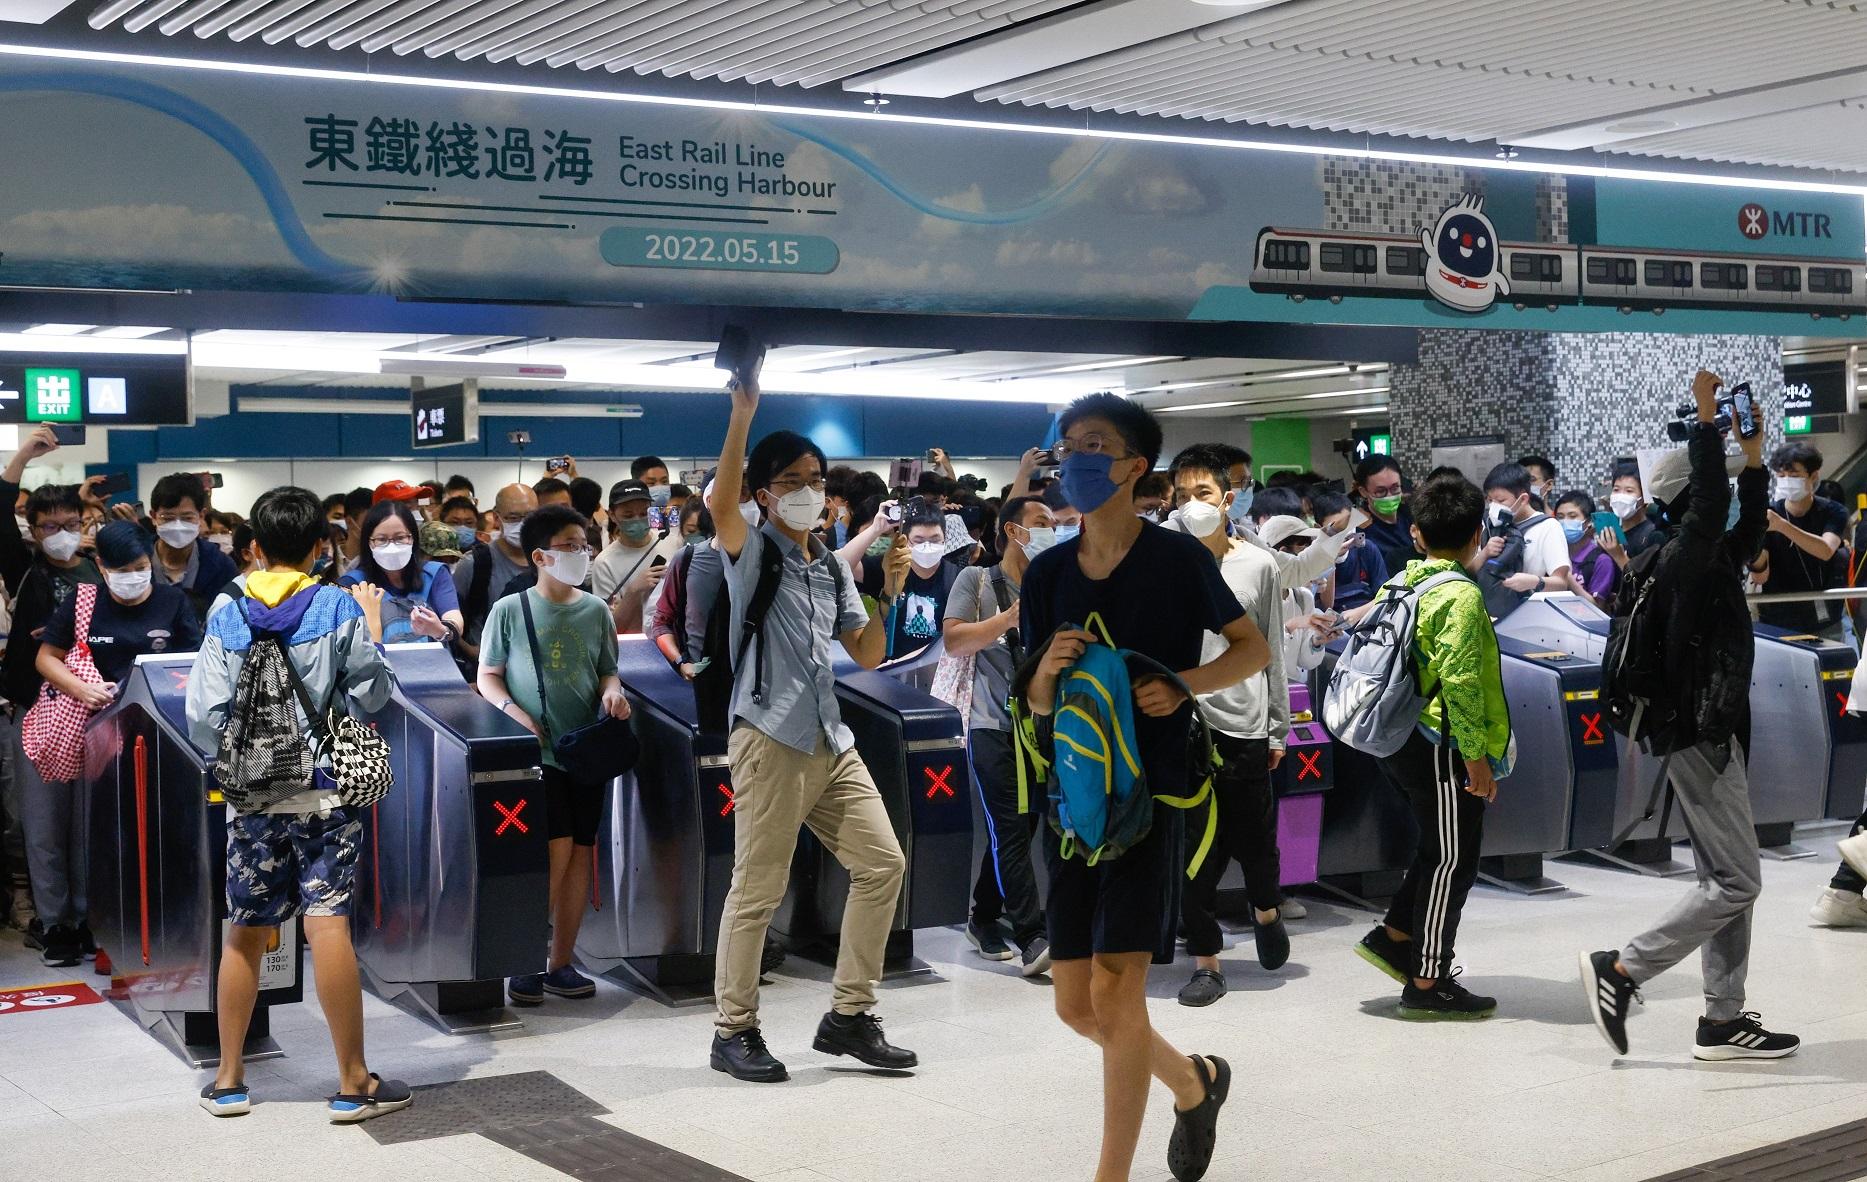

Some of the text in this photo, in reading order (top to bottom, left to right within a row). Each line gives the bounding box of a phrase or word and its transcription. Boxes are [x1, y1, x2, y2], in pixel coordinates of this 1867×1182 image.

[304, 113, 593, 186] 東鐵綫過海
[619, 135, 785, 168] East Rail Line
[619, 164, 837, 198] Crossing Harbour
[1773, 211, 1832, 238] MTR
[645, 234, 800, 265] 2022.05.15
[37, 375, 70, 403] 出
[96, 383, 119, 410] A
[1784, 383, 1811, 400] 中心
[38, 403, 70, 415] EXIT
[267, 956, 280, 964] 130
